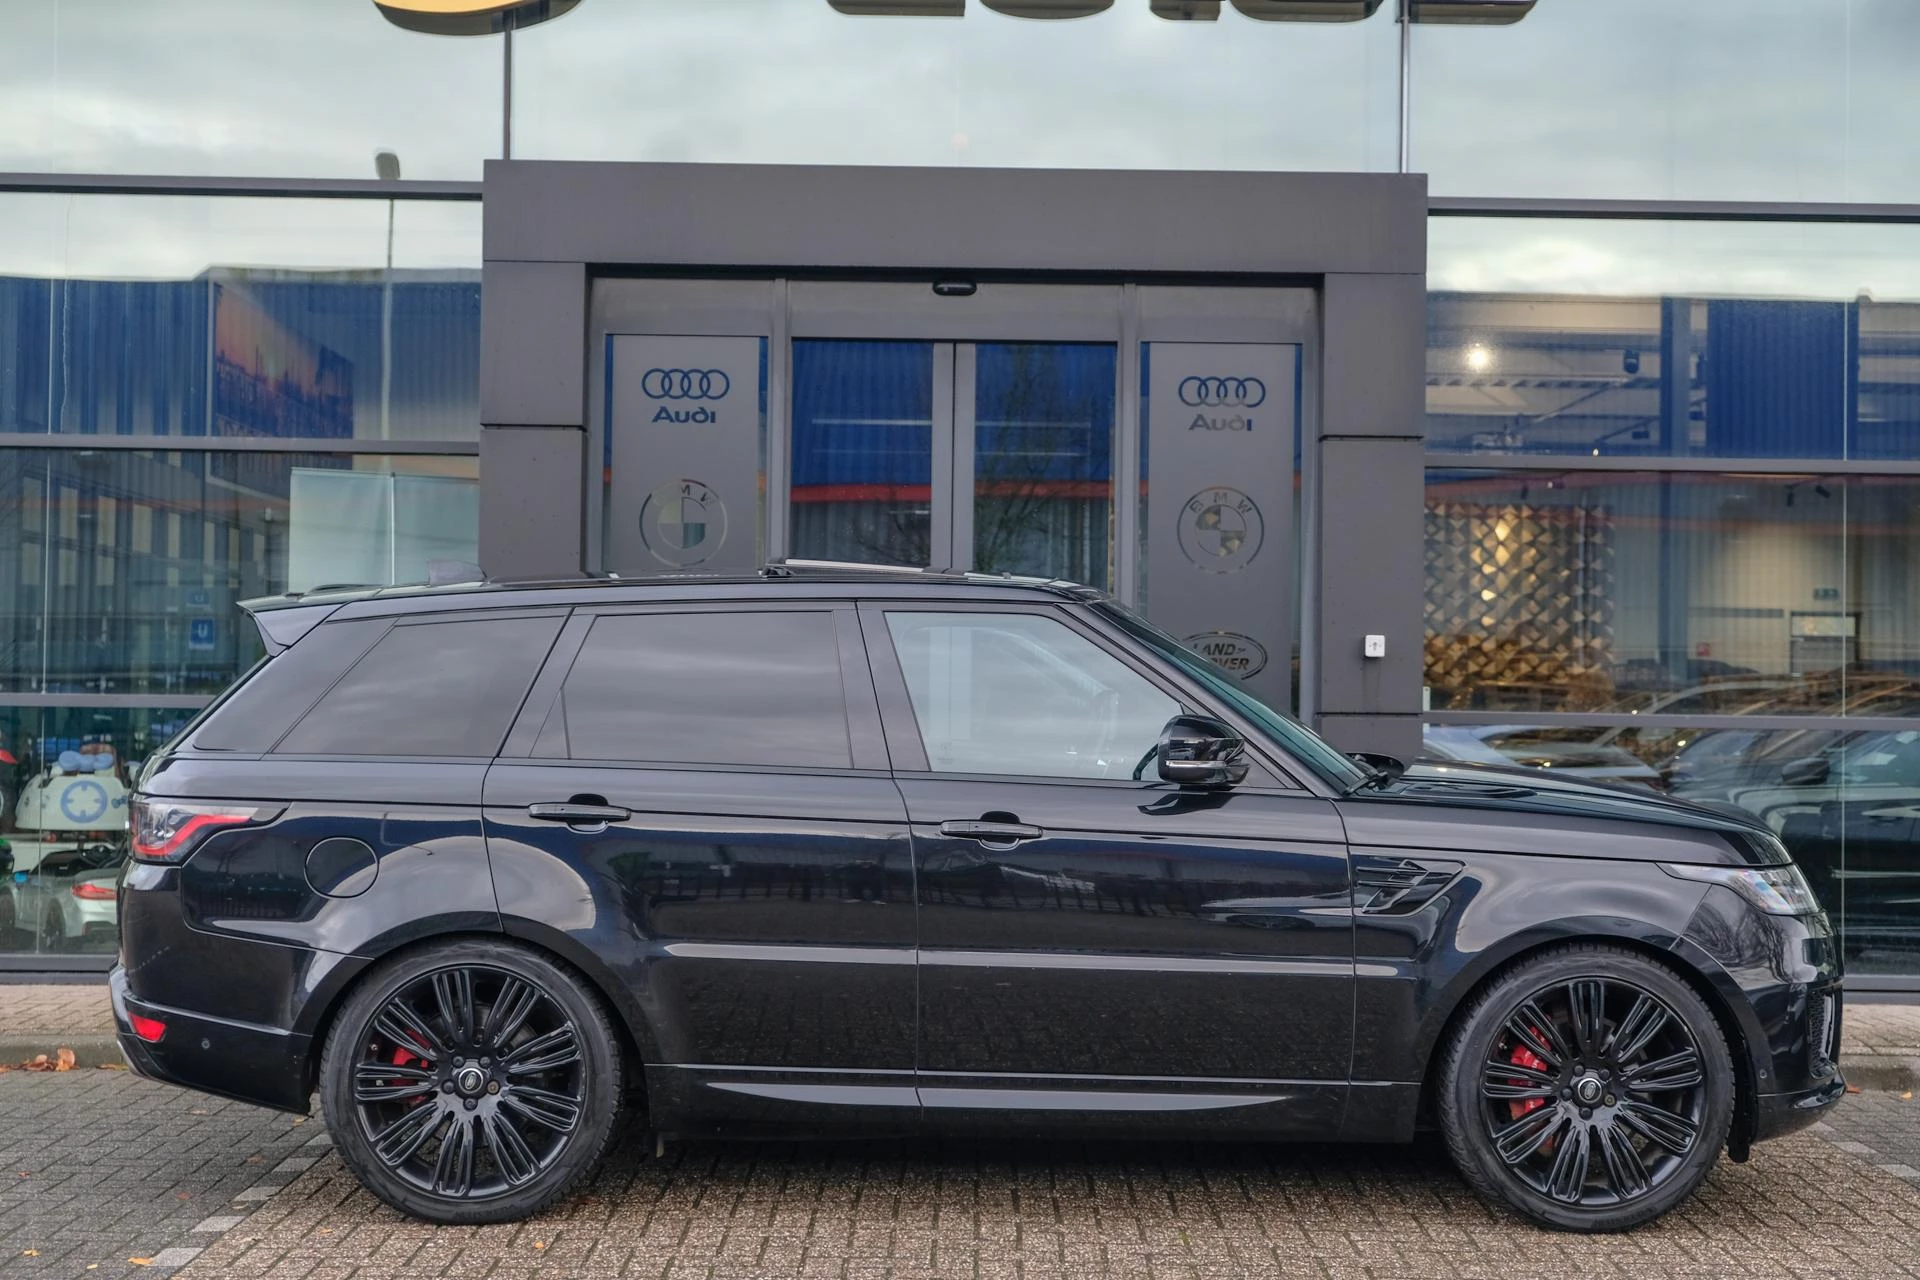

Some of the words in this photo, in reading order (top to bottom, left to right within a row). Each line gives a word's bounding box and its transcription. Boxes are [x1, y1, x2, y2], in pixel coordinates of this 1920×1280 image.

[652, 406, 716, 423] Audi
[1188, 414, 1252, 431] Audi
[1189, 491, 1252, 514] BMW
[1210, 657, 1250, 670] VER
